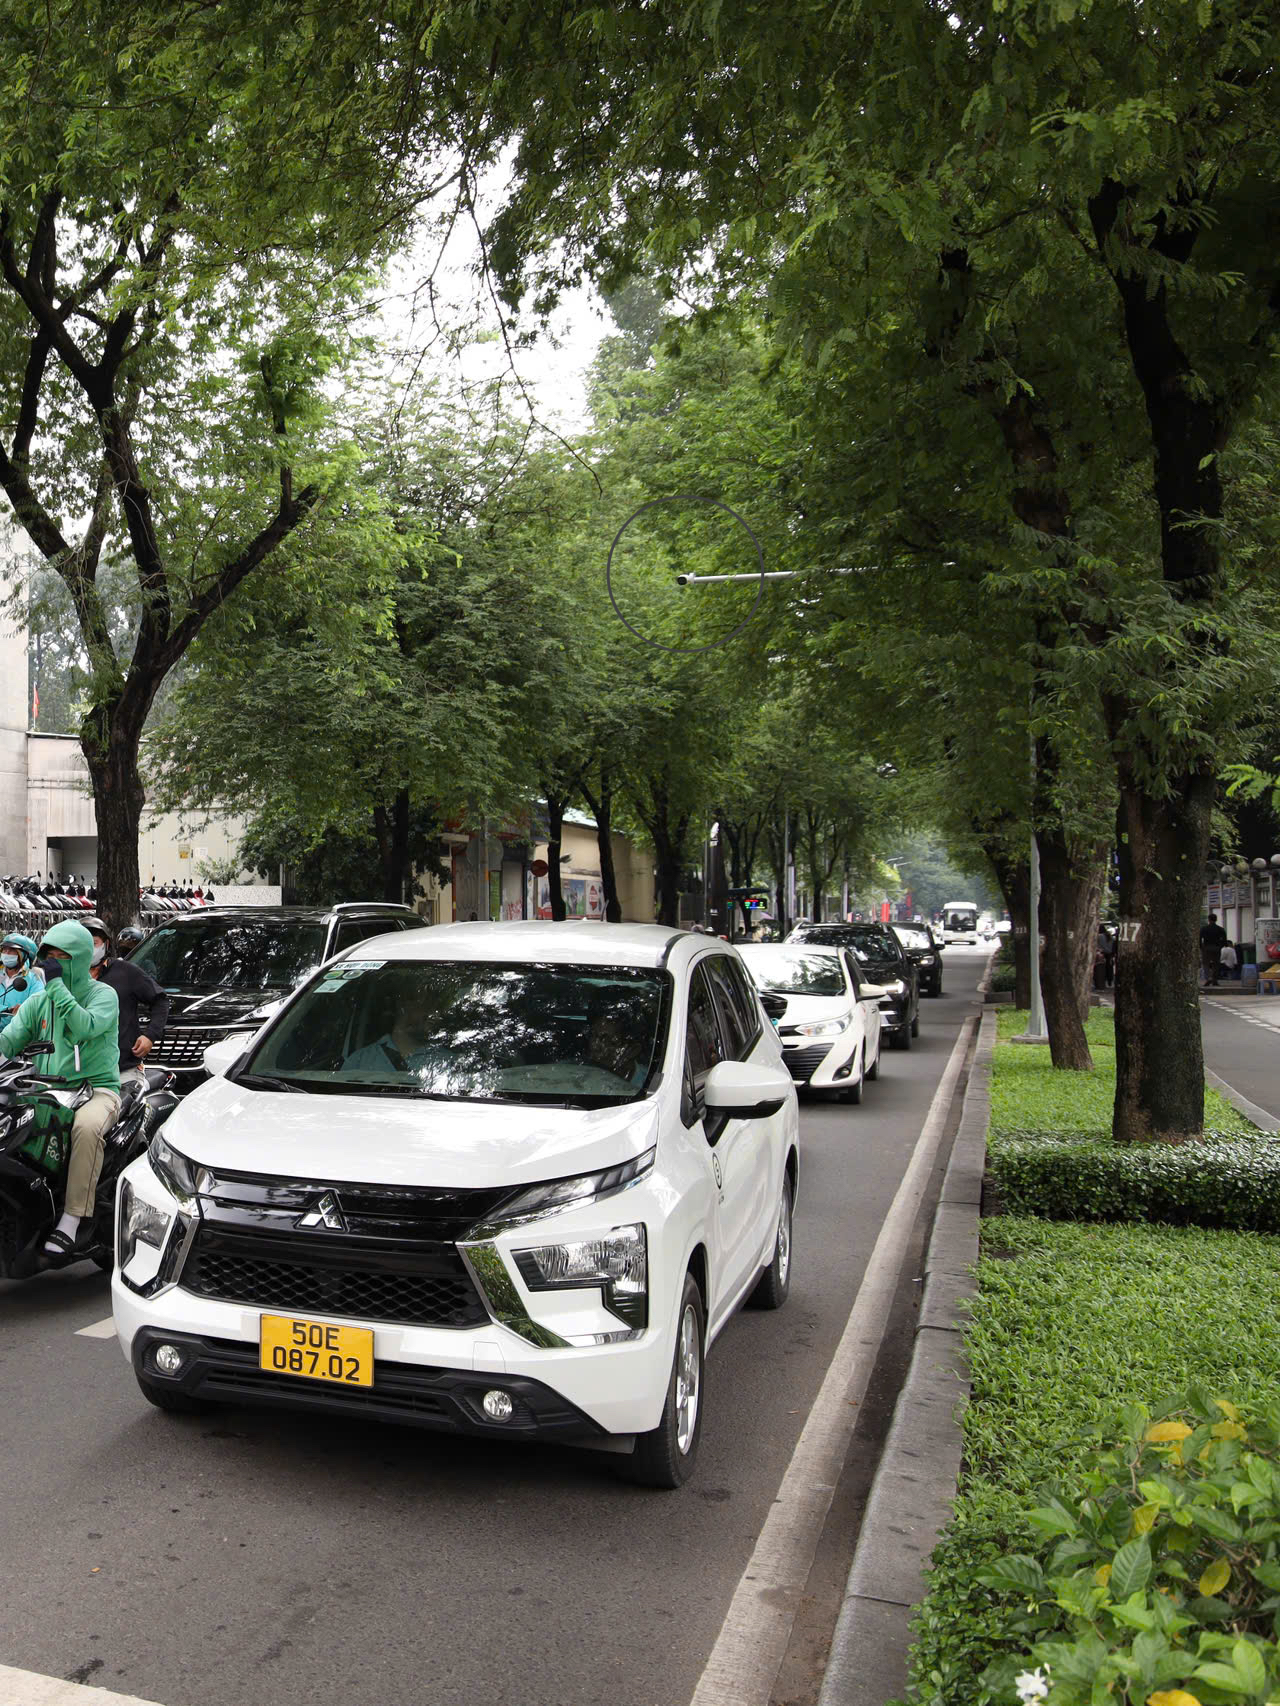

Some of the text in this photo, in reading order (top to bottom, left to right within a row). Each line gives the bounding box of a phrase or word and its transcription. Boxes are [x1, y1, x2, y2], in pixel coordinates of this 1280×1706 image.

[16, 1108, 35, 1129] 160
[292, 1321, 340, 1352] 50E
[272, 1346, 360, 1382] 087.02
